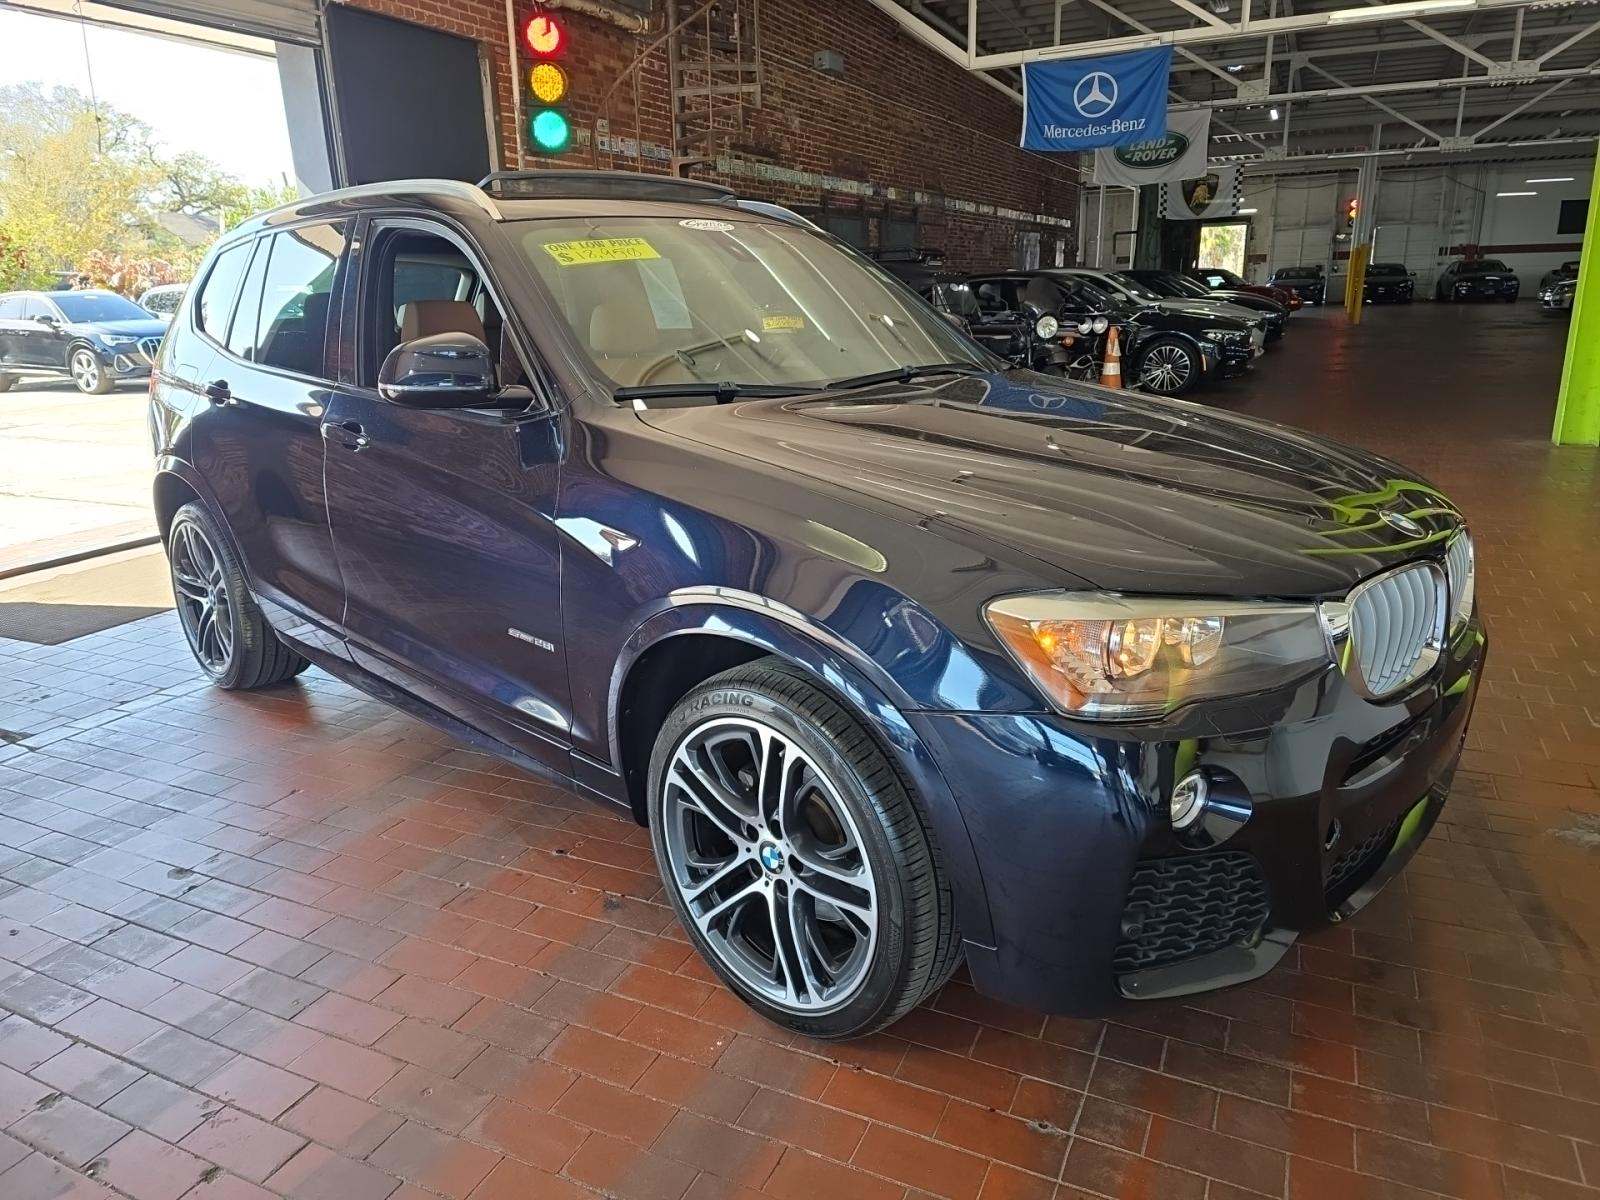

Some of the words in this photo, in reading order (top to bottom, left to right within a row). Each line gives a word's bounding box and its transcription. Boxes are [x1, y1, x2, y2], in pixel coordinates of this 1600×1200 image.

[1043, 117, 1146, 139] Mercedes-Benz
[1129, 138, 1167, 151] LAND
[1132, 148, 1178, 162] ROVER
[548, 242, 575, 252] ONE
[579, 240, 604, 249] LOW
[609, 239, 645, 247] PRICE
[690, 692, 755, 711] RACING
